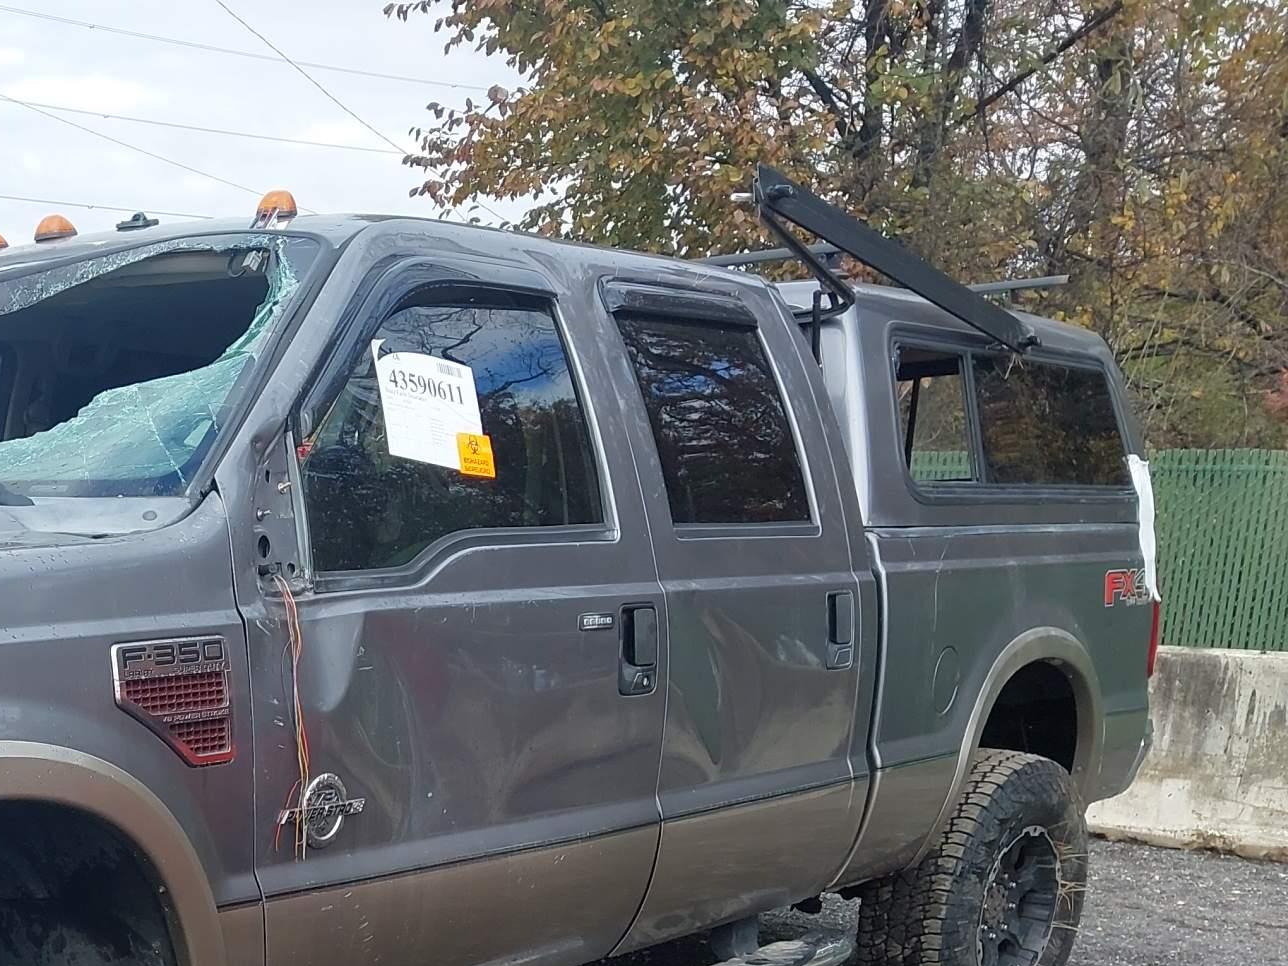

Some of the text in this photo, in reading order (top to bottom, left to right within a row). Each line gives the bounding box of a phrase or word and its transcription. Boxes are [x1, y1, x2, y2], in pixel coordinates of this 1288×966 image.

[388, 369, 464, 405] 43590611
[1104, 567, 1147, 609] FX4
[121, 640, 225, 671] F-350
